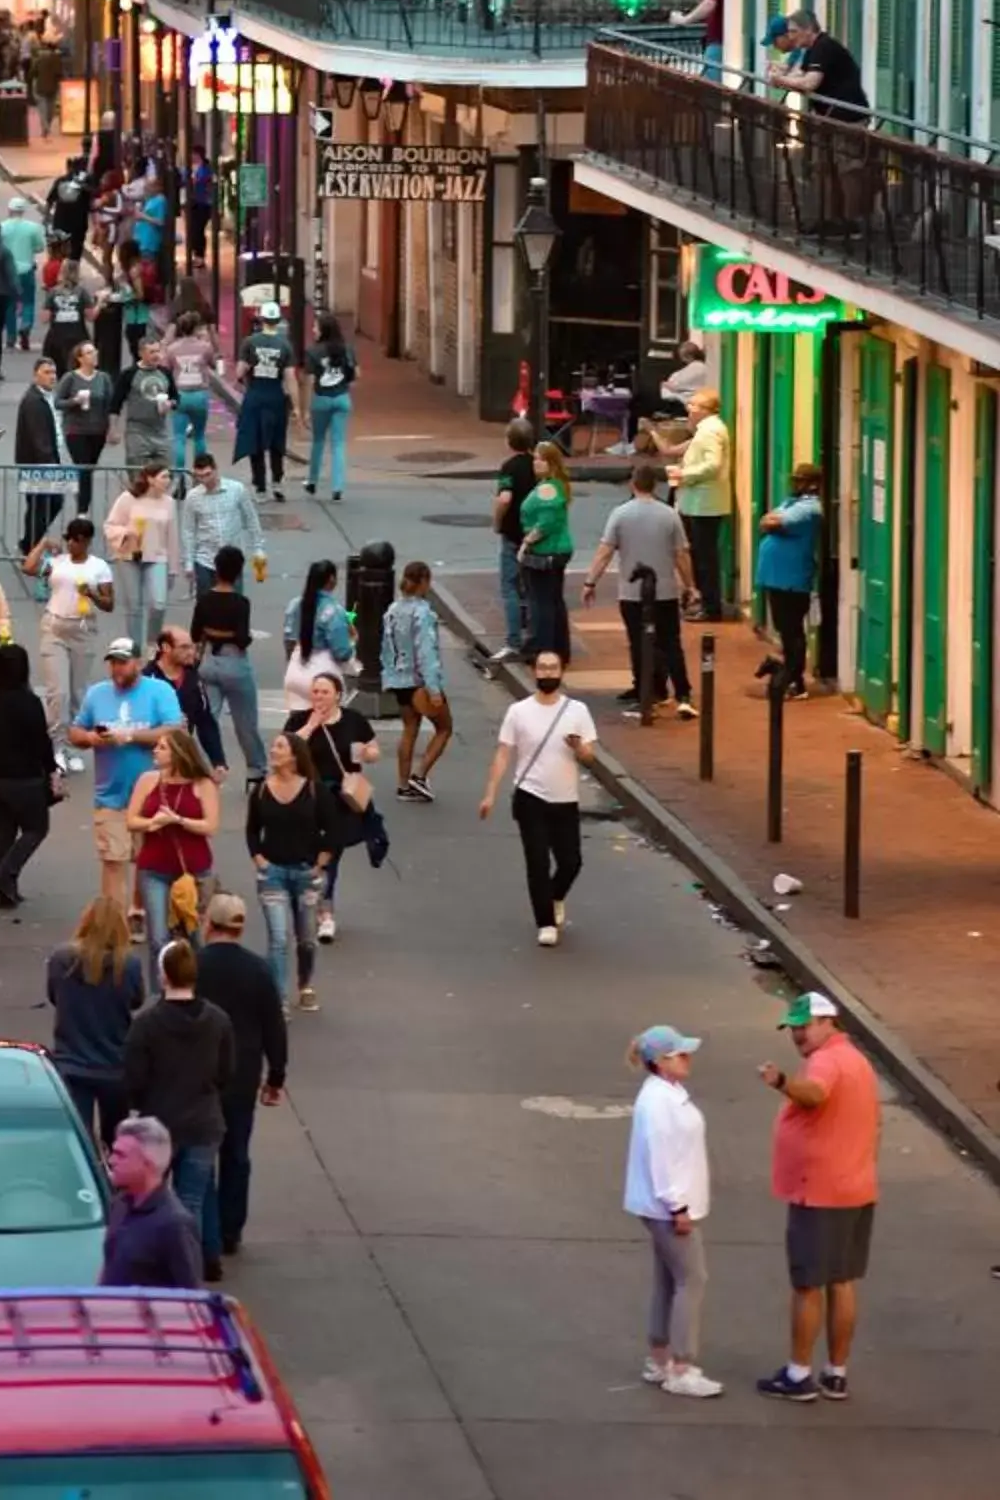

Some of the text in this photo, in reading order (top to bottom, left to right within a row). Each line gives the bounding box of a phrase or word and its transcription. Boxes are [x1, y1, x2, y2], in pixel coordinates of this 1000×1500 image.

[323, 145, 487, 164] AISON BOURBON
[411, 164, 430, 174] TO
[438, 165, 463, 175] THE
[317, 170, 487, 200] ESERVATION JAZZ
